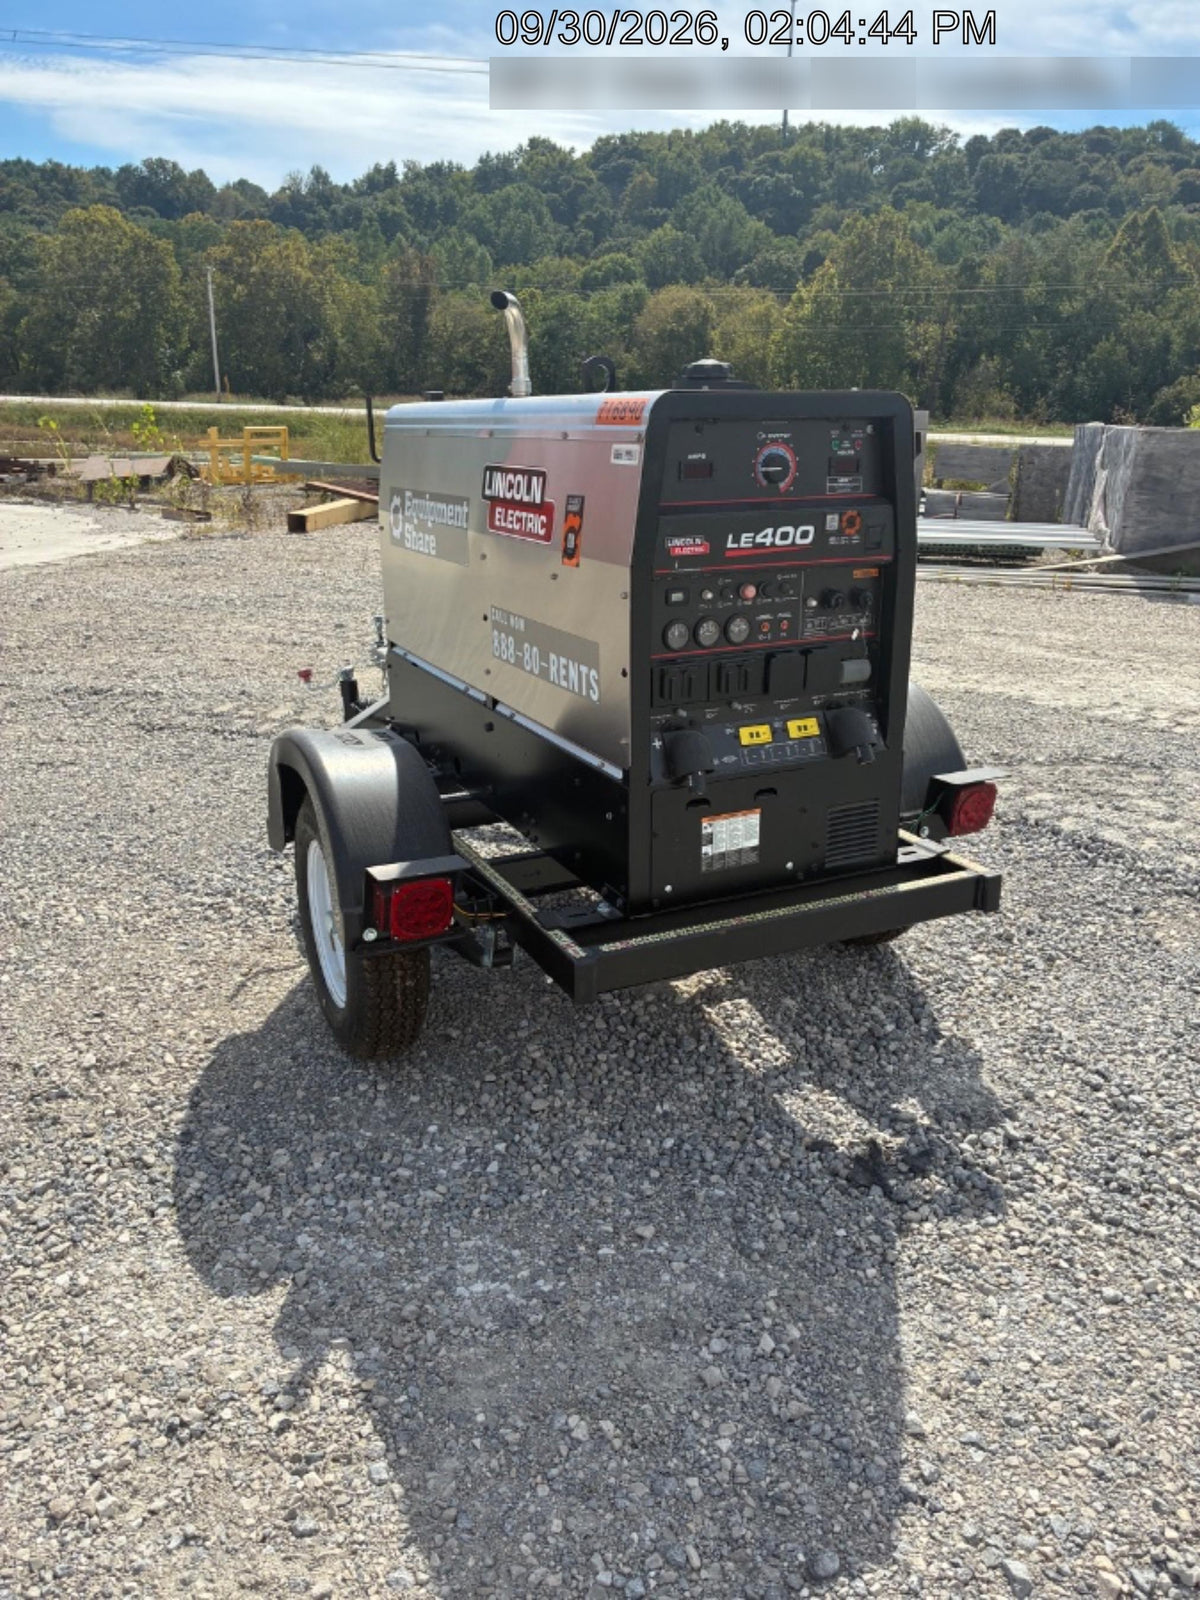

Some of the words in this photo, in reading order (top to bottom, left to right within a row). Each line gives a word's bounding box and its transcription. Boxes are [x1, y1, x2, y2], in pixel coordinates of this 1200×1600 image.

[484, 470, 543, 504] LINCOLN
[404, 490, 468, 529] Equipment
[495, 506, 547, 536] ELECTRIC
[404, 522, 437, 556] Share
[667, 537, 702, 547] LINCOLN
[675, 545, 705, 555] ELECTRIC
[726, 525, 815, 549] LE400
[493, 629, 600, 702] 888-80-RENTS
